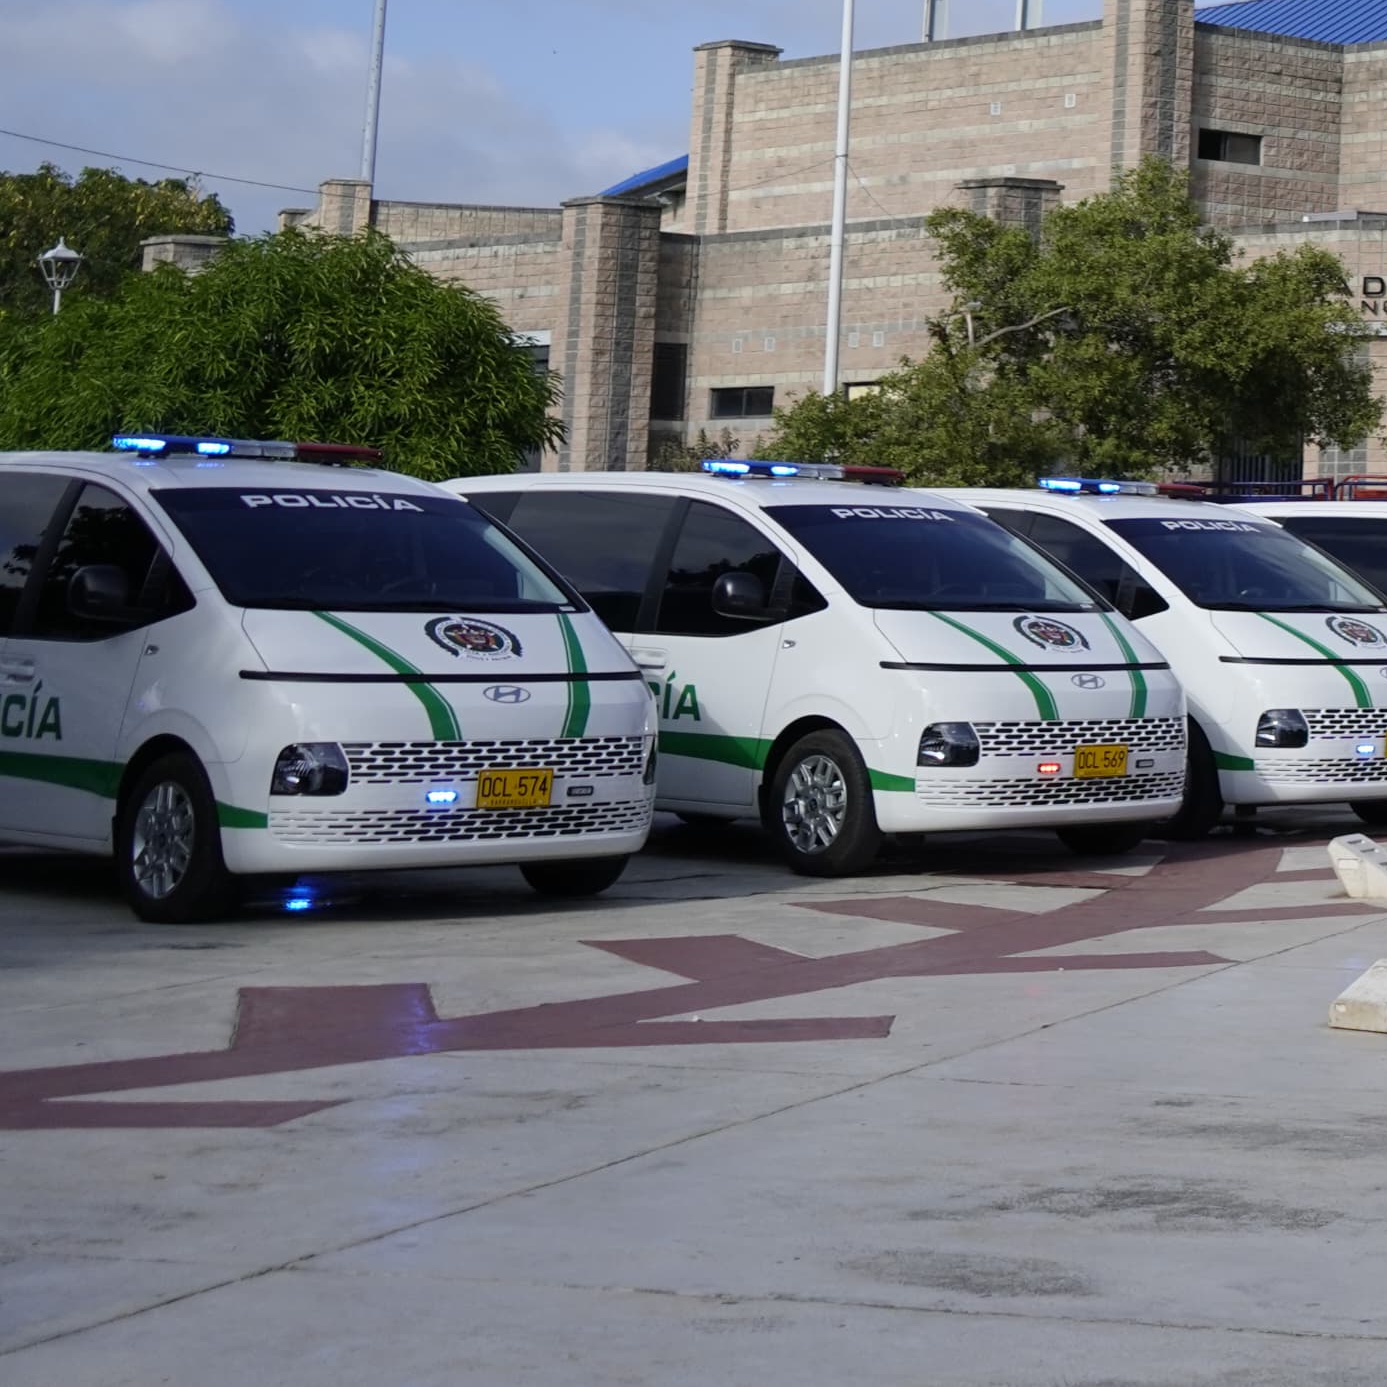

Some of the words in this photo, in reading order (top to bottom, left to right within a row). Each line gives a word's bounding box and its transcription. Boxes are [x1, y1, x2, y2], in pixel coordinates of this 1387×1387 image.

[240, 493, 425, 513] POLICÍA
[831, 507, 956, 522] POLICÍA
[1160, 519, 1262, 534] POLICÍA
